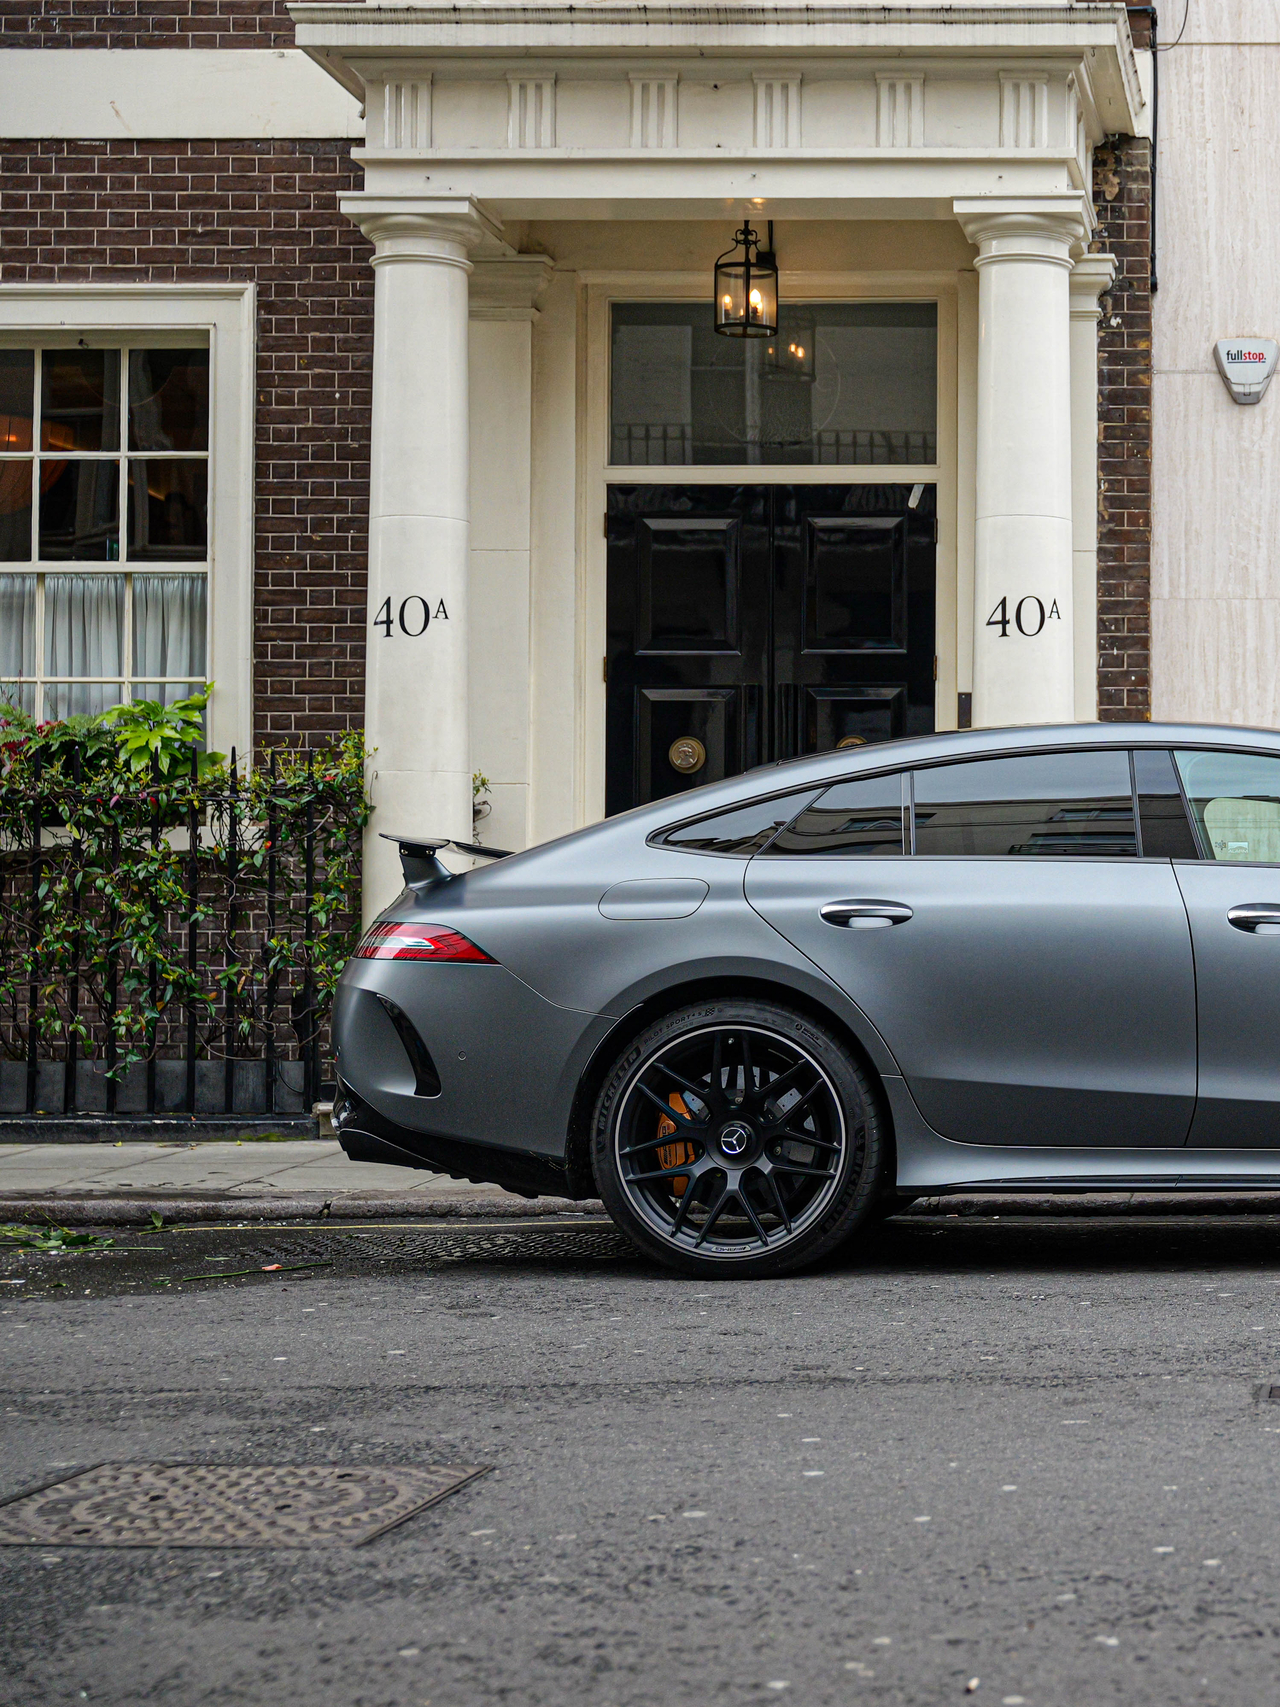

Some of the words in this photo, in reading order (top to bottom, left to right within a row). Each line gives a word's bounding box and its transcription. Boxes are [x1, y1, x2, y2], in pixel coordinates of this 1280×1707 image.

[1226, 350, 1267, 363] fullstop.
[373, 596, 450, 638] 40A
[985, 595, 1062, 638] 40A
[598, 1051, 640, 1130] MICHELIN
[643, 1028, 664, 1045] PILOT
[665, 1014, 692, 1030] SPORT
